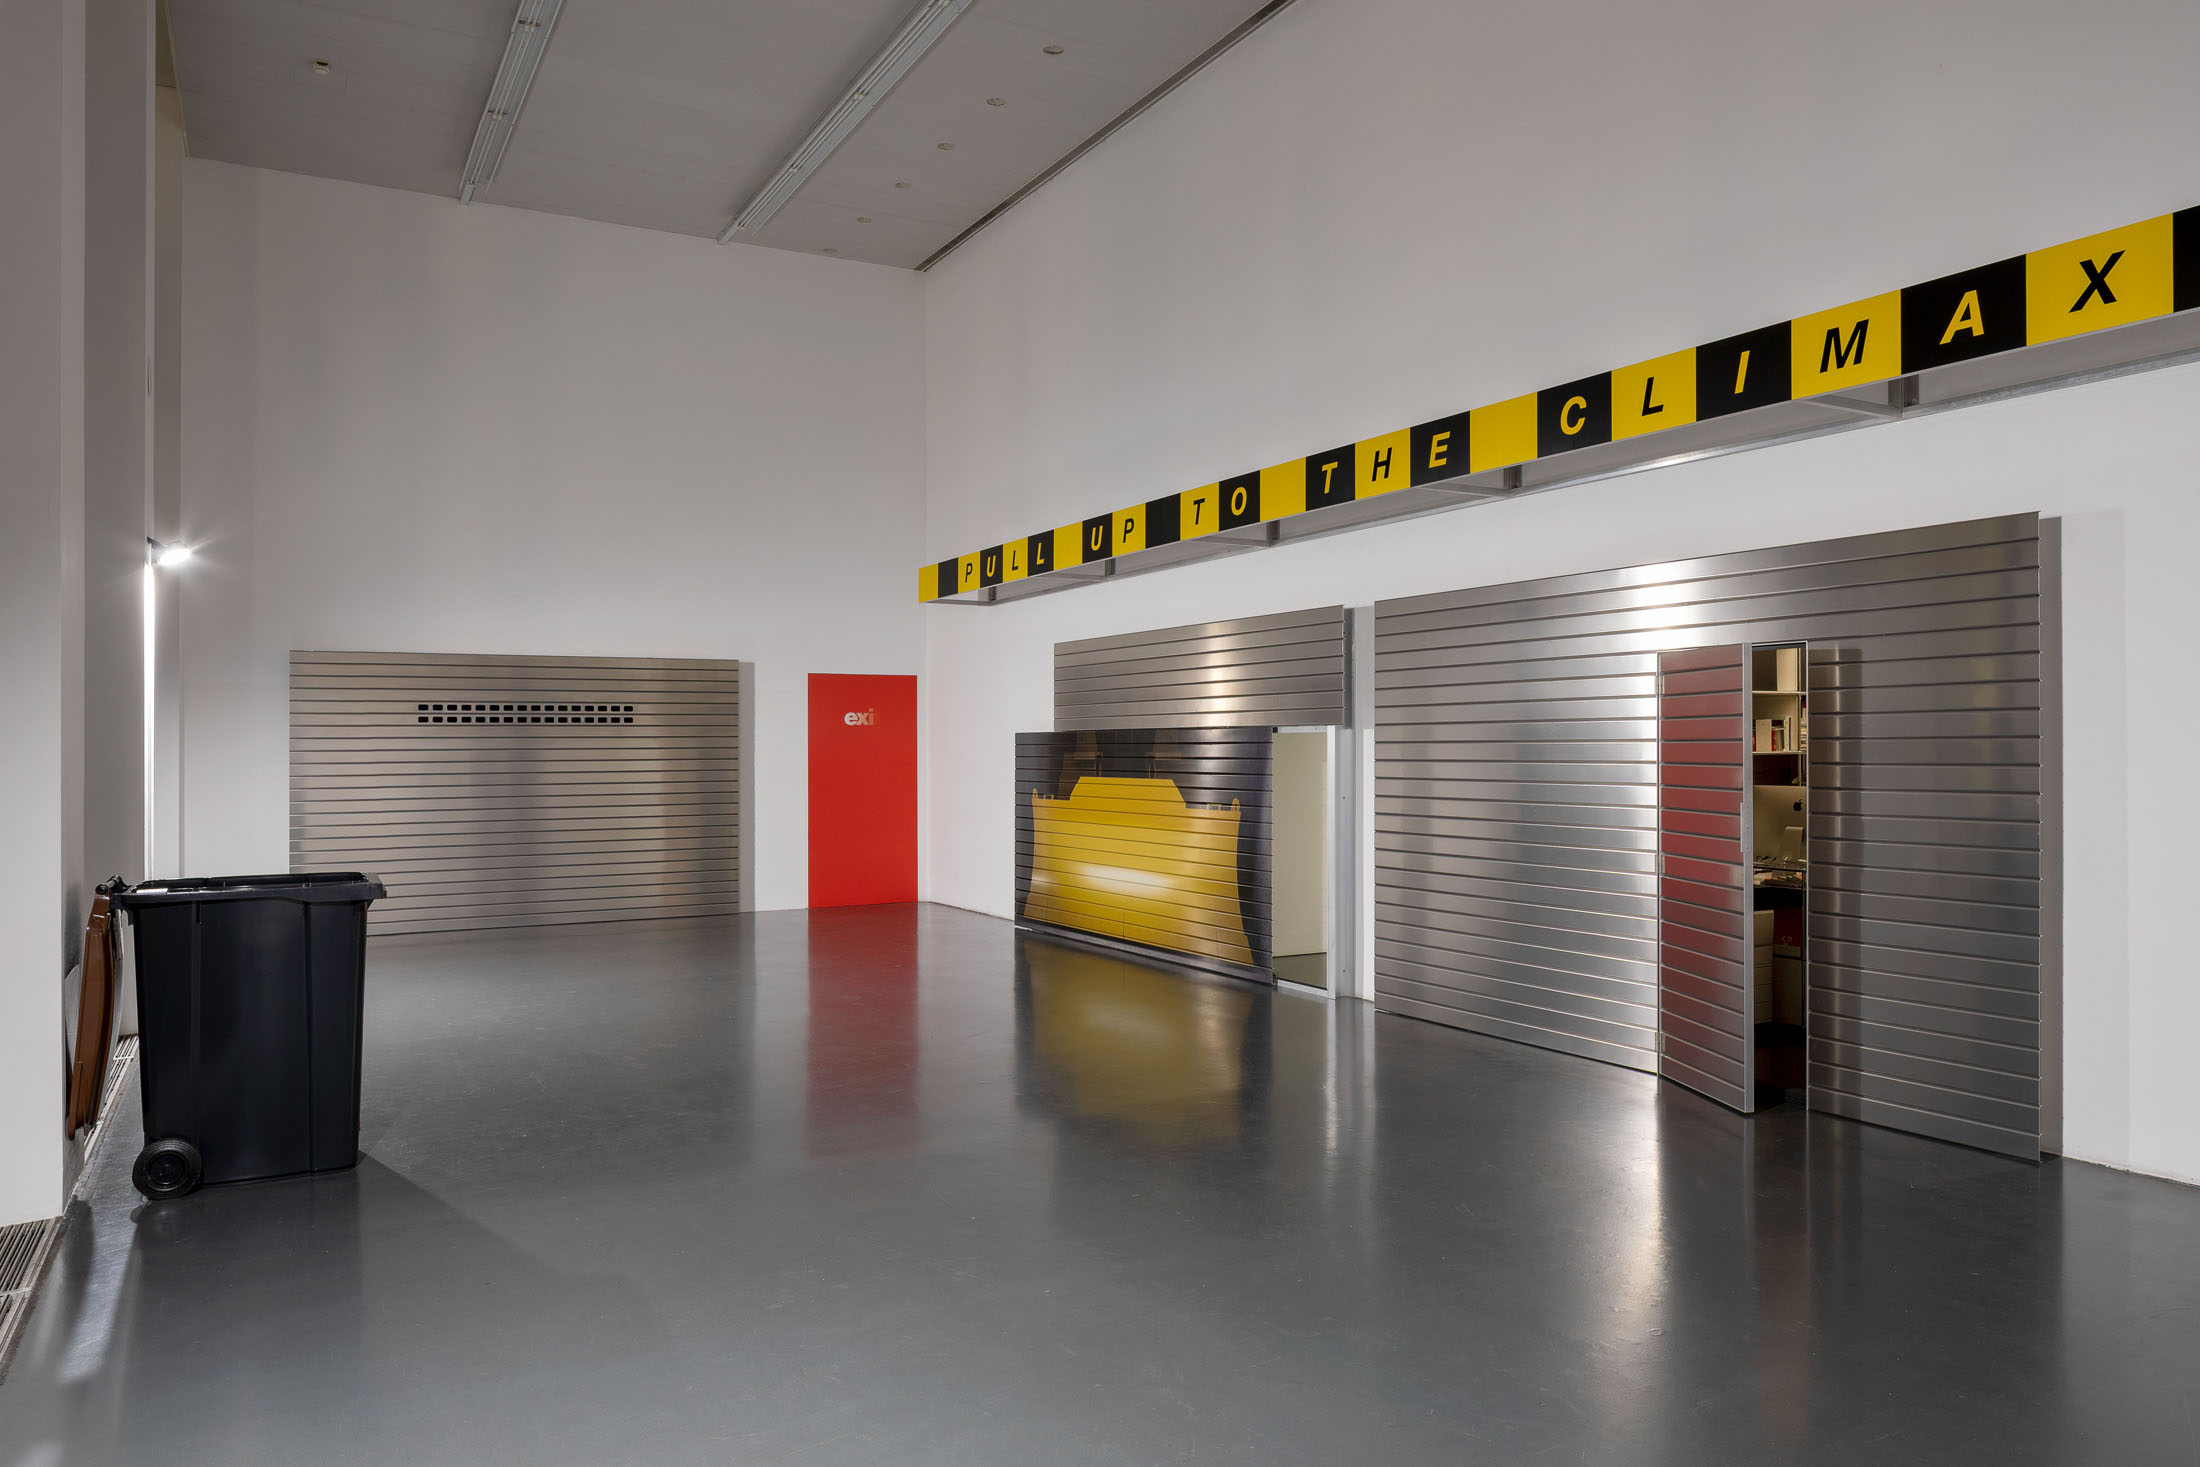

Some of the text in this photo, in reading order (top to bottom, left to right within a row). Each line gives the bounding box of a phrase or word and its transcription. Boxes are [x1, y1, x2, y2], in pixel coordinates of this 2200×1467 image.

[965, 249, 2126, 583] PULL UP TO THE CLIMAX
[844, 707, 875, 726] exi
